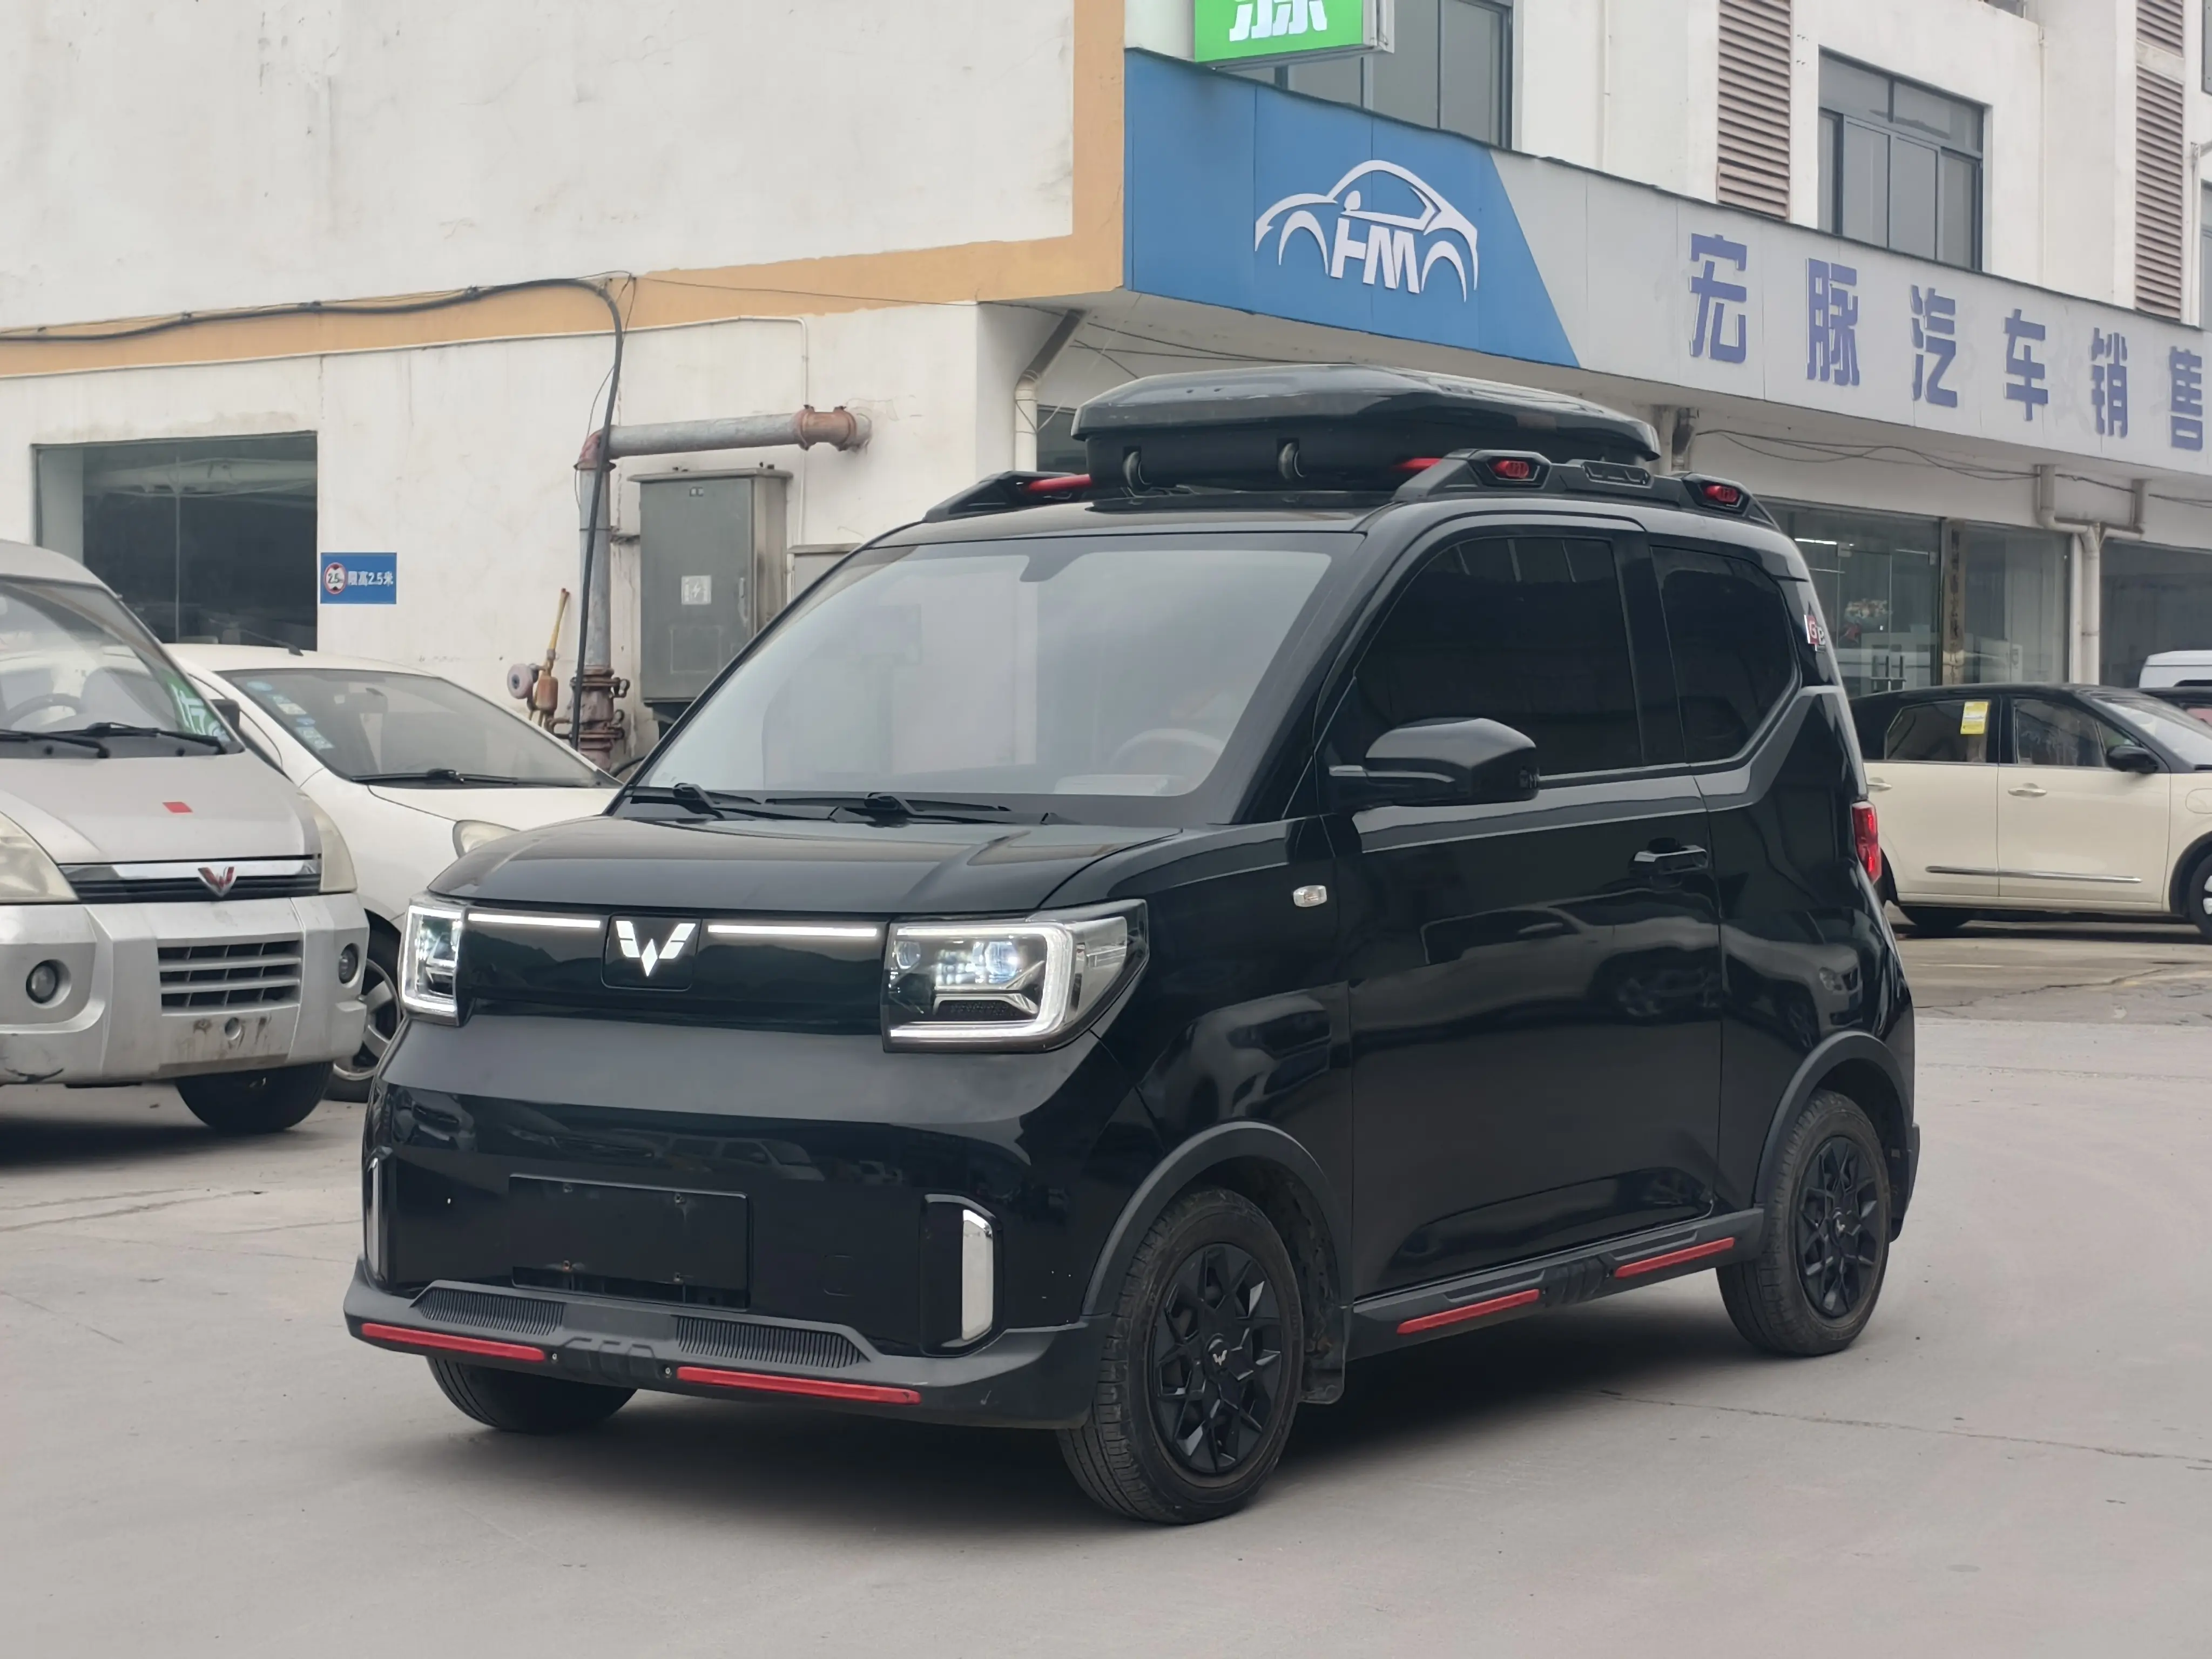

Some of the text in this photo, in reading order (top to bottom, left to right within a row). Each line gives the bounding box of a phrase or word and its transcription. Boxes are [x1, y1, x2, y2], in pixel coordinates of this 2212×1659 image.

[1689, 233, 2204, 453] 宏脉汽车销售
